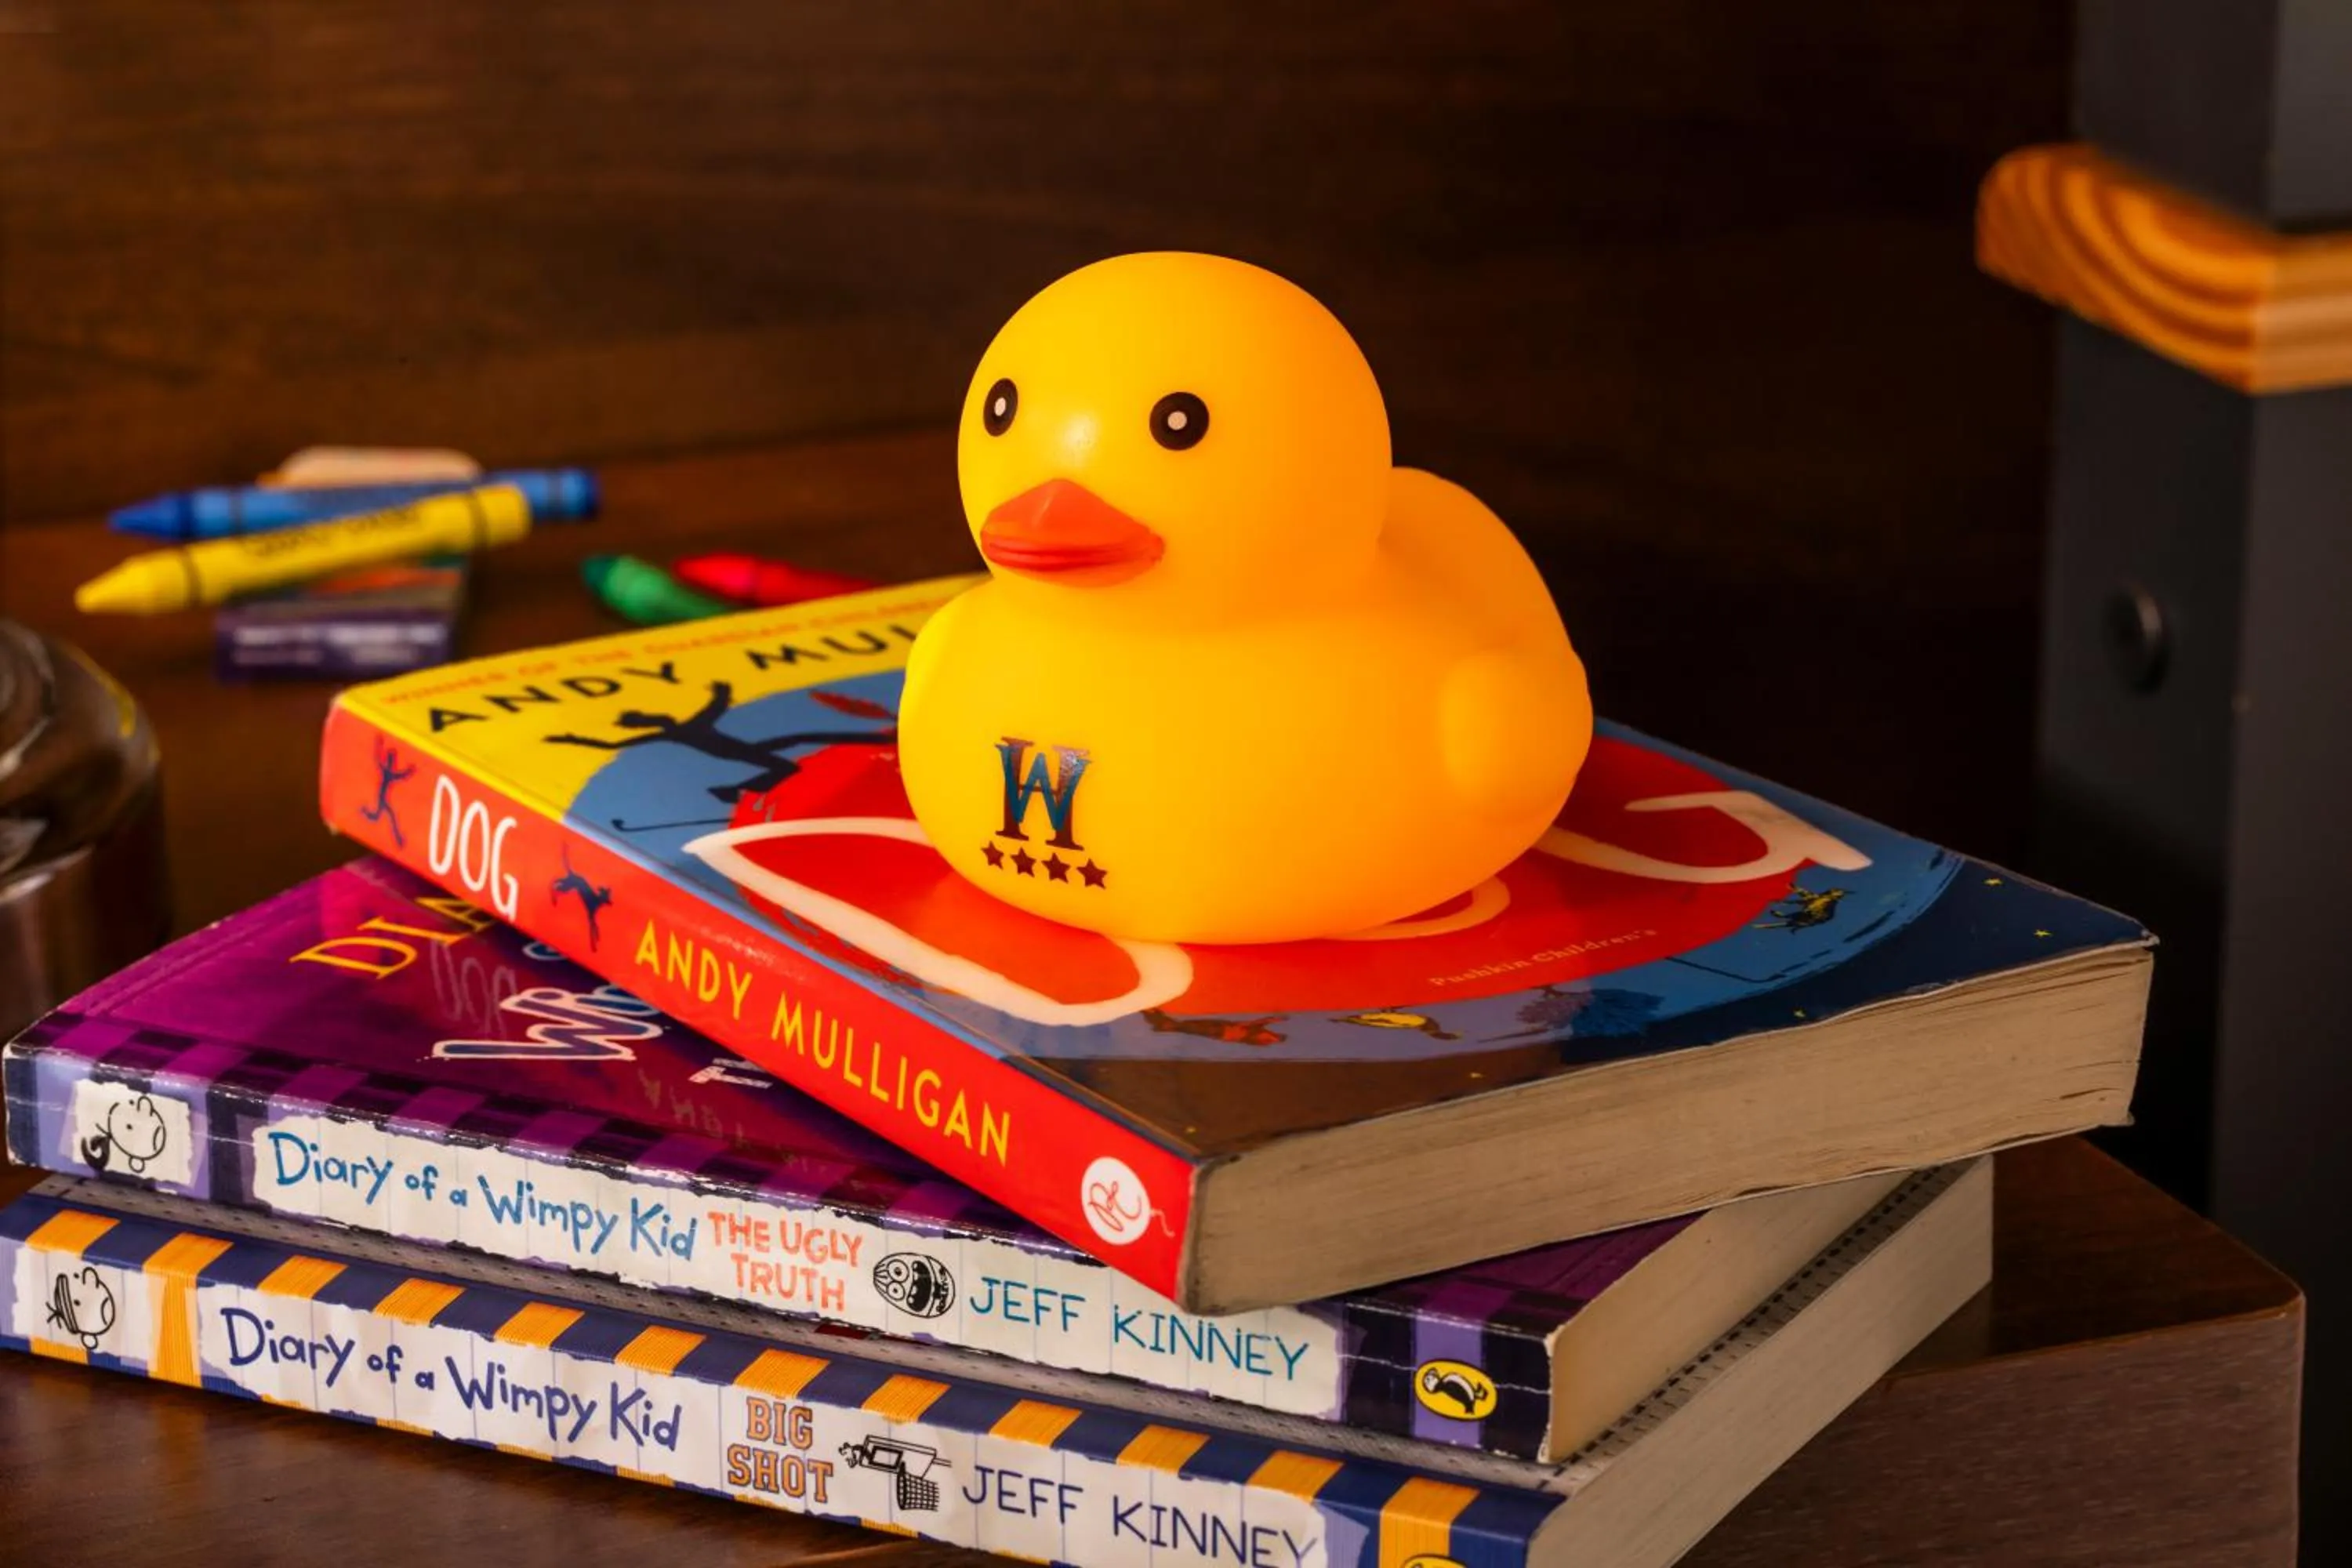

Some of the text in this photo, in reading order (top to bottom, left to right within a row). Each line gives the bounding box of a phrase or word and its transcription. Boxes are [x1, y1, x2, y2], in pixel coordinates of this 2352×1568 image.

[428, 661, 681, 733] ANDY
[428, 775, 518, 922] DOG
[1427, 960, 1531, 986] Pushkin
[634, 919, 753, 1020] ANDY
[771, 990, 1011, 1168] MULLIGAN
[268, 1131, 698, 1261] Diary of a Wimpy Kid
[706, 1210, 862, 1269] THE UGLY
[730, 1253, 846, 1312] TRUTH
[969, 1276, 1087, 1333] JEFF
[1113, 1304, 1310, 1381] KINNEY
[220, 1307, 682, 1452] Diary of a Wimpy Kid
[746, 1396, 814, 1450] BIG
[726, 1443, 834, 1504] SHOT
[962, 1463, 1317, 1568] JEFF KINNEY
